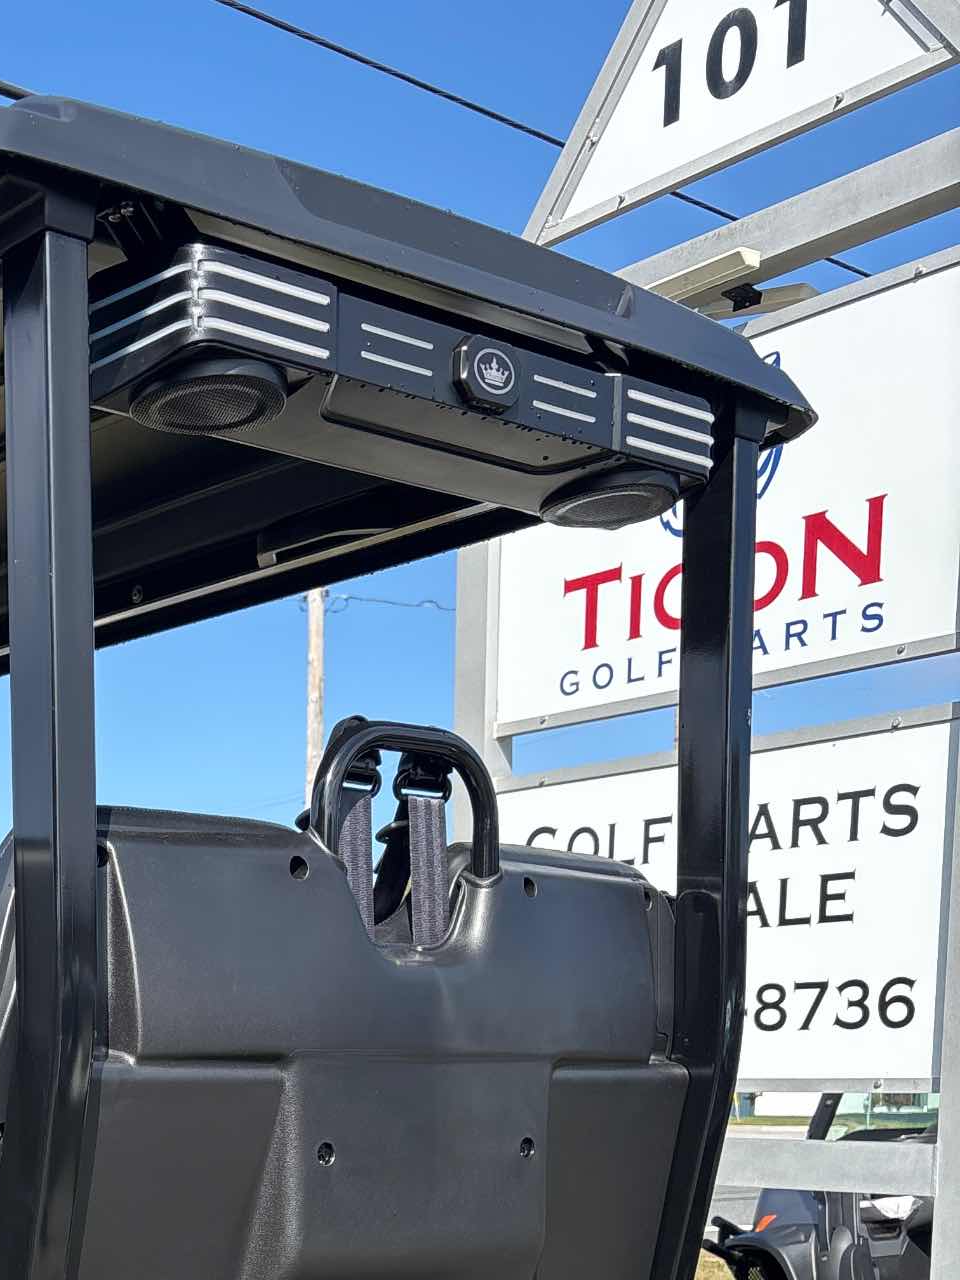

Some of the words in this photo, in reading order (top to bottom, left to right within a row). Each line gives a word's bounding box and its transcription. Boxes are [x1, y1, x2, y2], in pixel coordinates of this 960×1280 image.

[652, 0, 808, 128] 101
[559, 648, 677, 696] GOLF
[752, 602, 885, 656] ARTS
[748, 783, 921, 853] ARTS
[746, 868, 856, 928] ALE
[753, 976, 918, 1032] 8736
